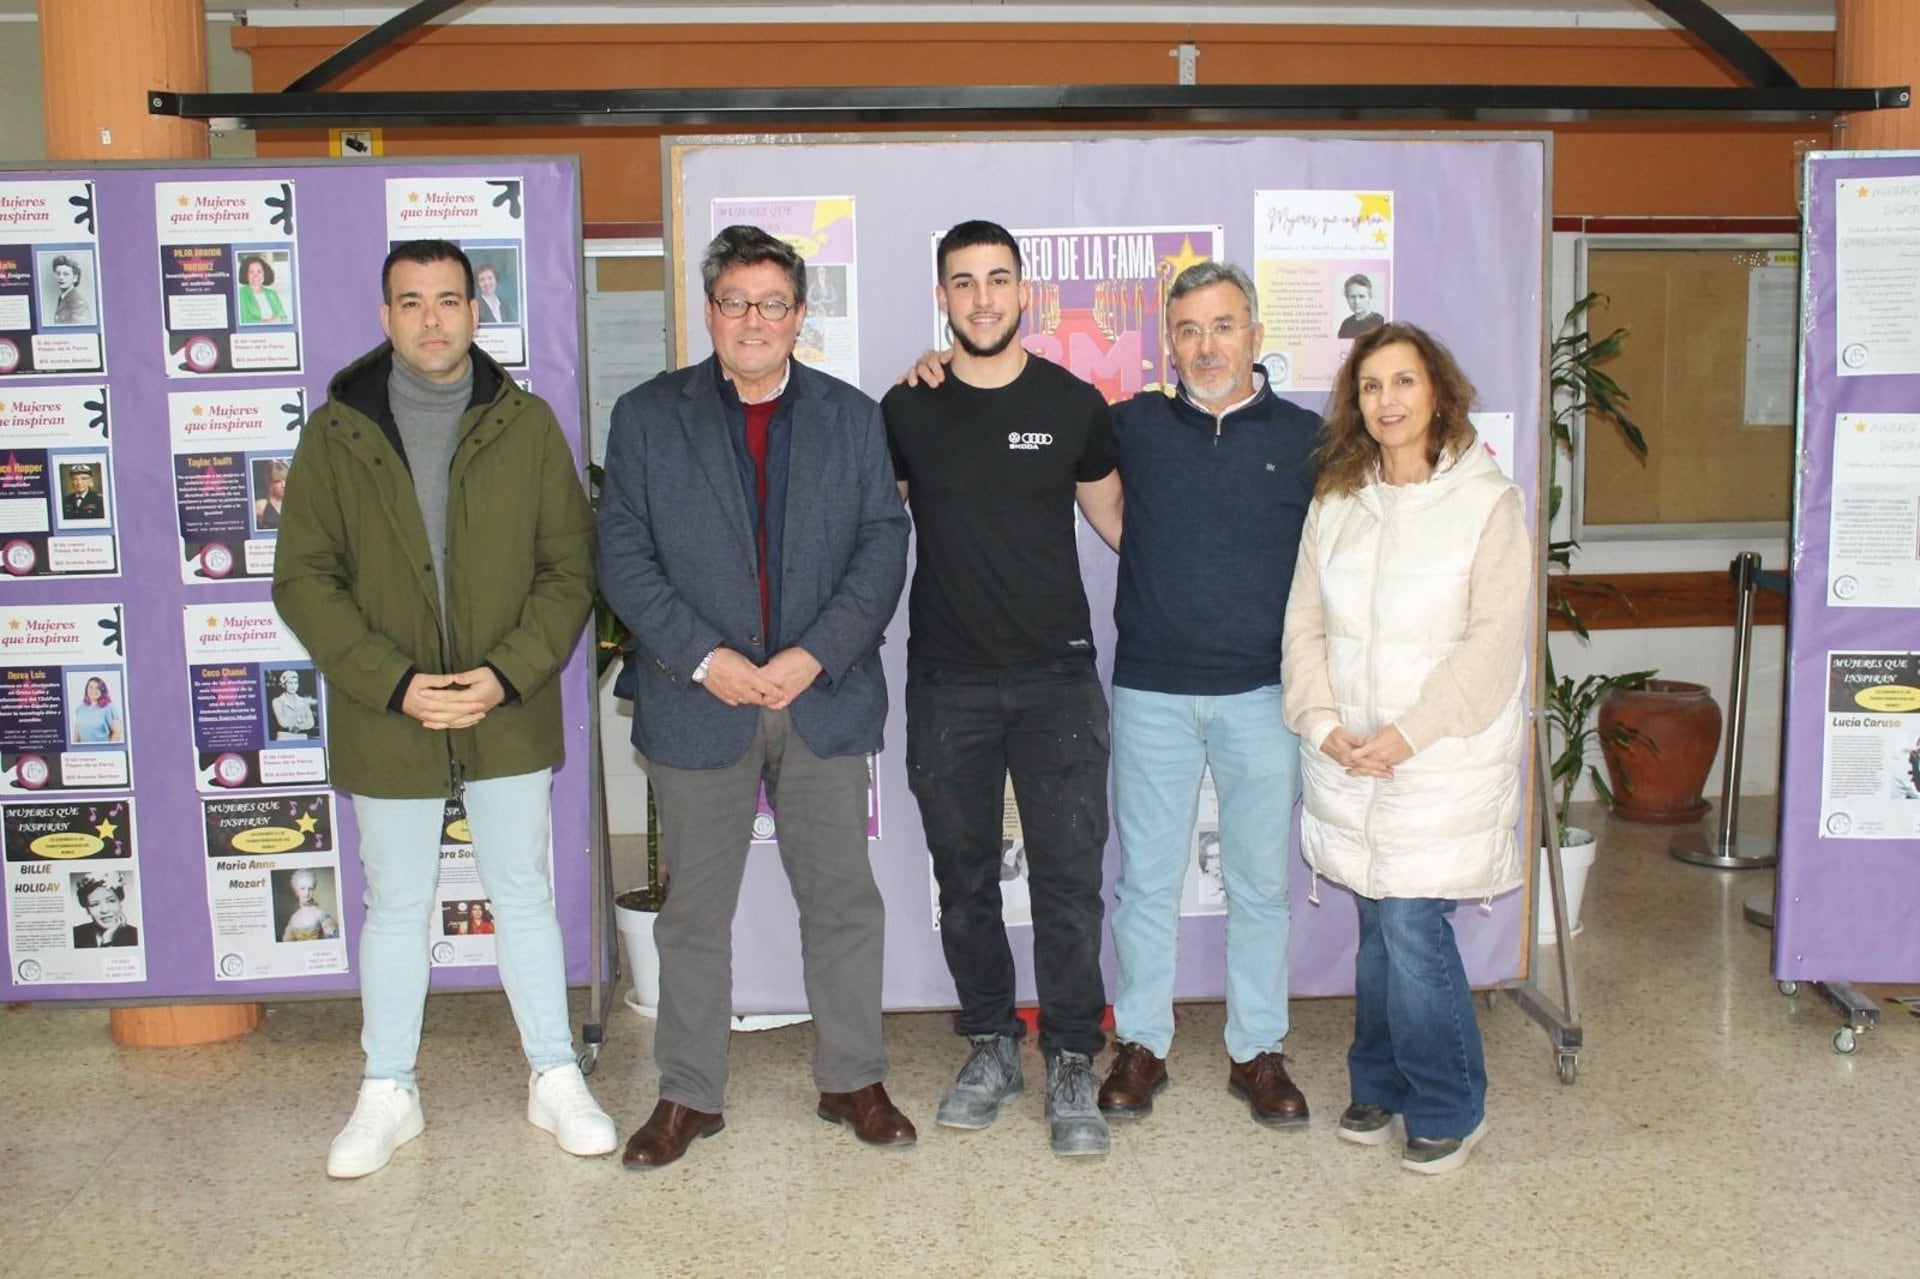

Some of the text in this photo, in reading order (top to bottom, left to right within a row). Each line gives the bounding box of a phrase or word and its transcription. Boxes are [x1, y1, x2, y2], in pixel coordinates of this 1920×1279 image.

[195, 195, 246, 209] Mujeres
[424, 192, 476, 206] Mujeres
[0, 210, 50, 224] nspiran
[170, 210, 250, 225] que inspiran
[400, 206, 478, 221] que inspiran
[719, 206, 794, 217] MUJERES QUE
[1020, 234, 1157, 281] SEO DE LA FAMA
[11, 401, 62, 414] Mujeres
[209, 405, 259, 418] Mujeres
[12, 415, 65, 428] inspiran
[184, 419, 262, 433] que inspiran
[14, 463, 43, 474] Hopper
[187, 457, 233, 468] Taylor Swift
[26, 619, 75, 633] Mujeres
[223, 616, 273, 630] Mujeres
[1, 633, 80, 647] que inspiran
[200, 629, 277, 645] que inspiran
[1833, 659, 1909, 669] MUJERES QUE
[202, 666, 247, 678] Coco Chanel
[1844, 674, 1898, 683] INSPIRAN
[1863, 718, 1901, 728] Caruso
[6, 807, 80, 818] MUJERES QUE
[207, 801, 281, 813] MUJERES QUE
[18, 822, 70, 832] INSPIRAN
[220, 816, 271, 828] INSPIRAN
[20, 864, 52, 874] BILLIE
[249, 859, 276, 870] Anna
[14, 882, 61, 894] HOLIDAY
[229, 877, 266, 889] Mozart
